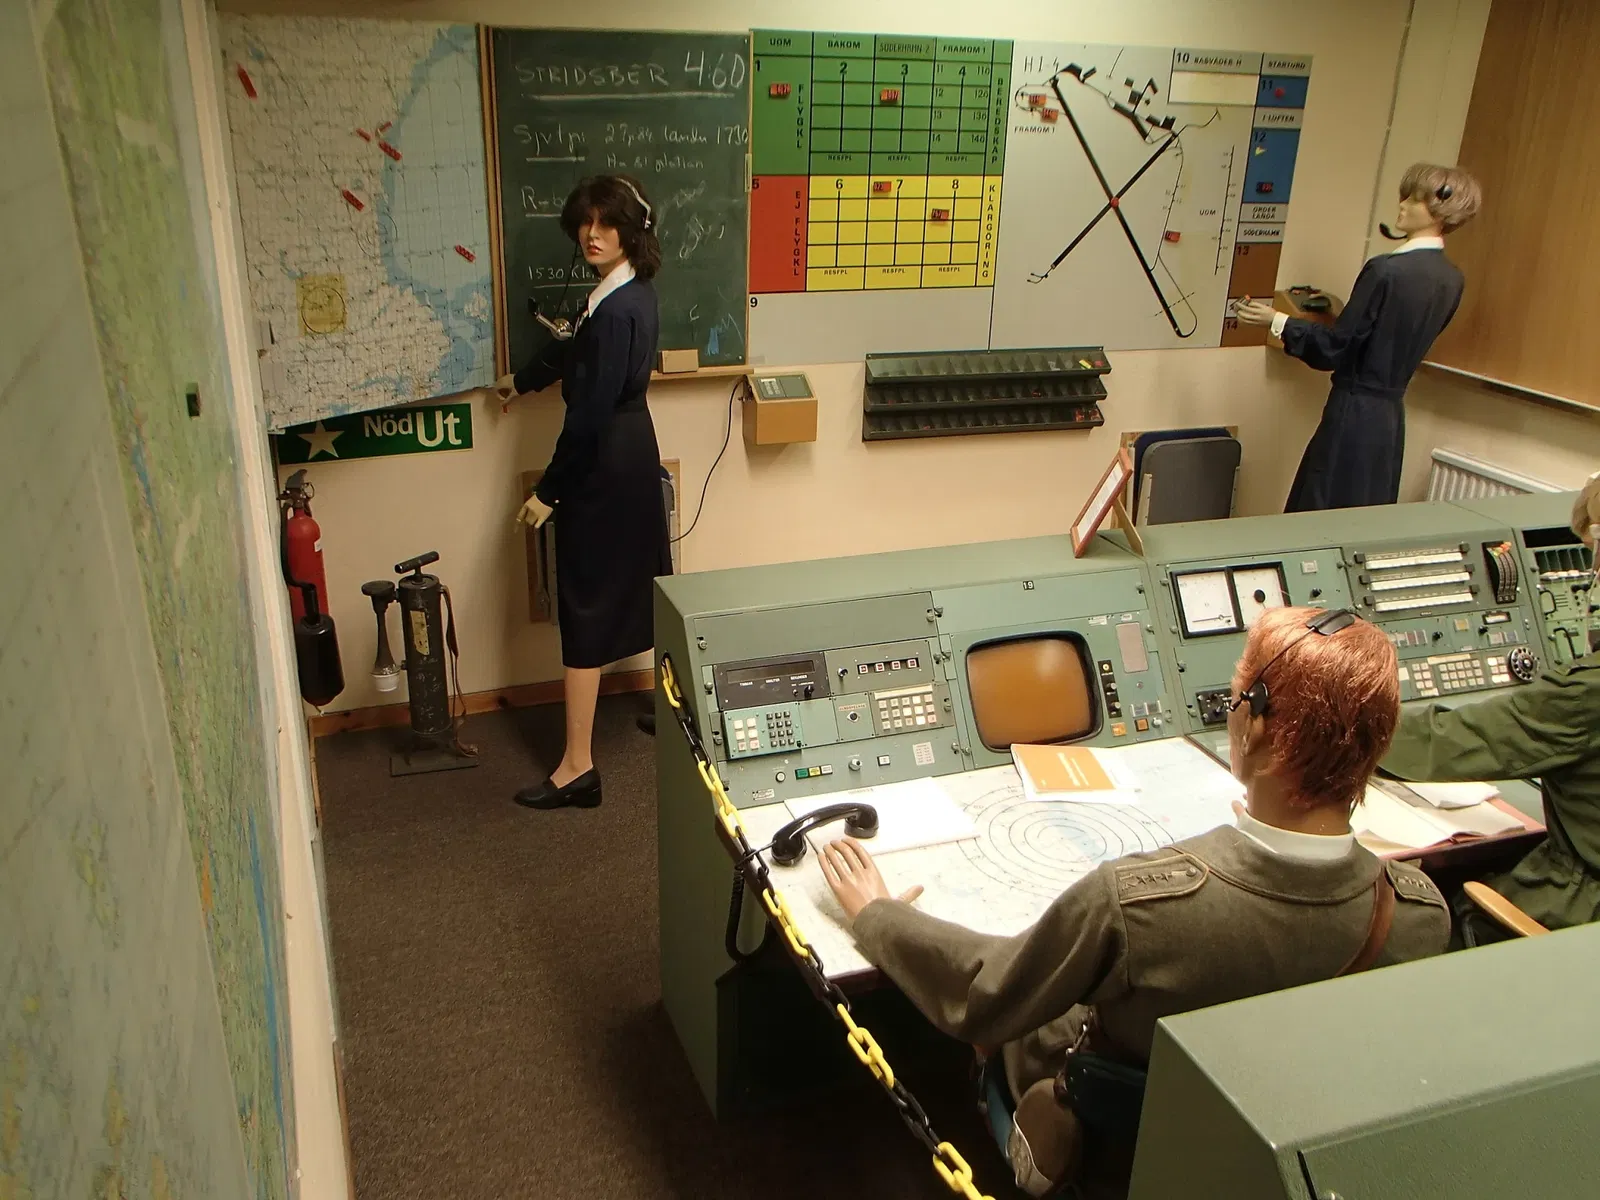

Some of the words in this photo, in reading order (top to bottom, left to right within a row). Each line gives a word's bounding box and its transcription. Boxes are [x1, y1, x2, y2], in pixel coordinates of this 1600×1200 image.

[769, 38, 791, 47] UOM
[1176, 52, 1190, 64] 10
[755, 59, 761, 72] 1
[839, 61, 848, 75] 2
[900, 63, 909, 76] 3
[958, 66, 966, 77] 4
[752, 179, 760, 189] 5
[835, 178, 844, 190] 6
[896, 179, 903, 190] 7
[951, 179, 960, 190] 8
[528, 265, 564, 280] 1530
[750, 297, 758, 308] 9
[364, 412, 413, 438] Nöd
[415, 410, 462, 447] Ut
